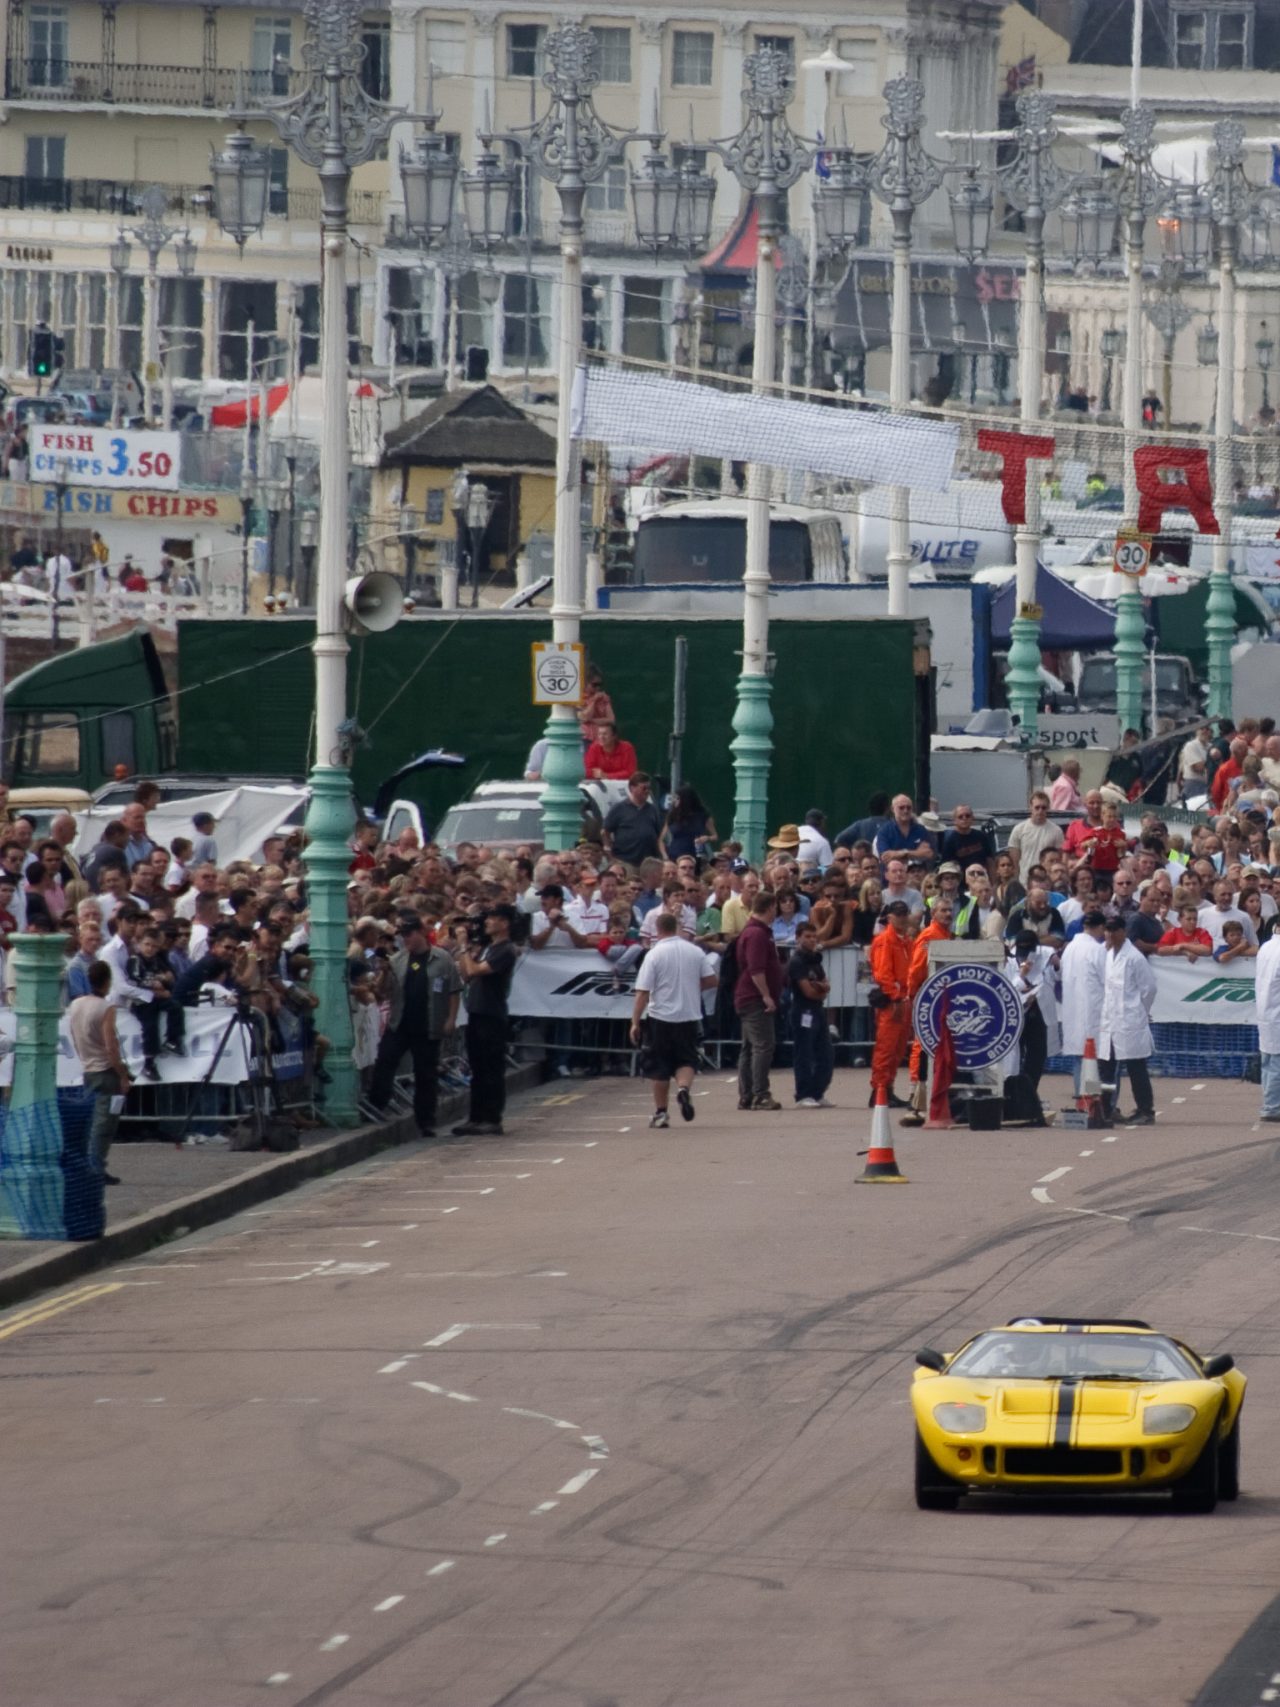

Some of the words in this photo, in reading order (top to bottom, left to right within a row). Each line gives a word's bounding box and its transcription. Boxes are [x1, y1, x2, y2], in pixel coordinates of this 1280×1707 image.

[42, 433, 94, 452] FISH
[107, 437, 172, 477] 3.50
[43, 489, 113, 513] FISH
[127, 495, 218, 517] CHIPS
[1120, 546, 1143, 565] 30
[548, 678, 569, 691] 30
[1036, 726, 1099, 747] sport
[928, 974, 952, 998] AND
[957, 968, 993, 983] HOVE
[995, 982, 1018, 1027] MOTOR
[986, 1032, 1013, 1060] CLUB
